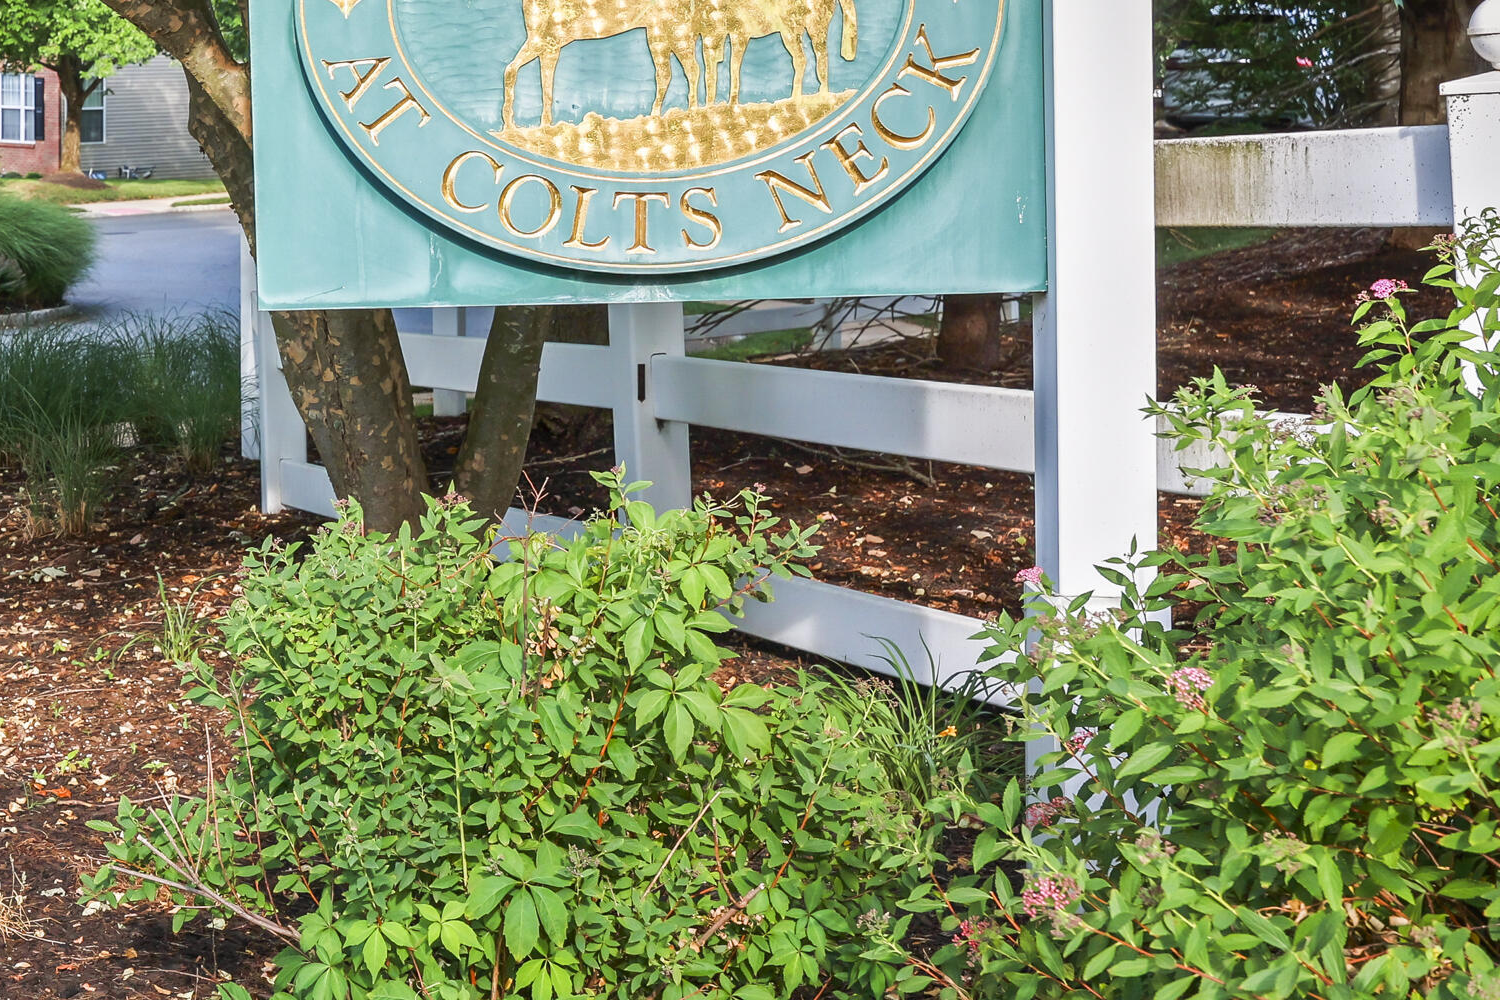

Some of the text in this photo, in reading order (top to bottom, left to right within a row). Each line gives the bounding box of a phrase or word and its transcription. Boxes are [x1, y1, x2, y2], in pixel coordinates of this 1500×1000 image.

[321, 23, 981, 253] AT COLTS NECK
